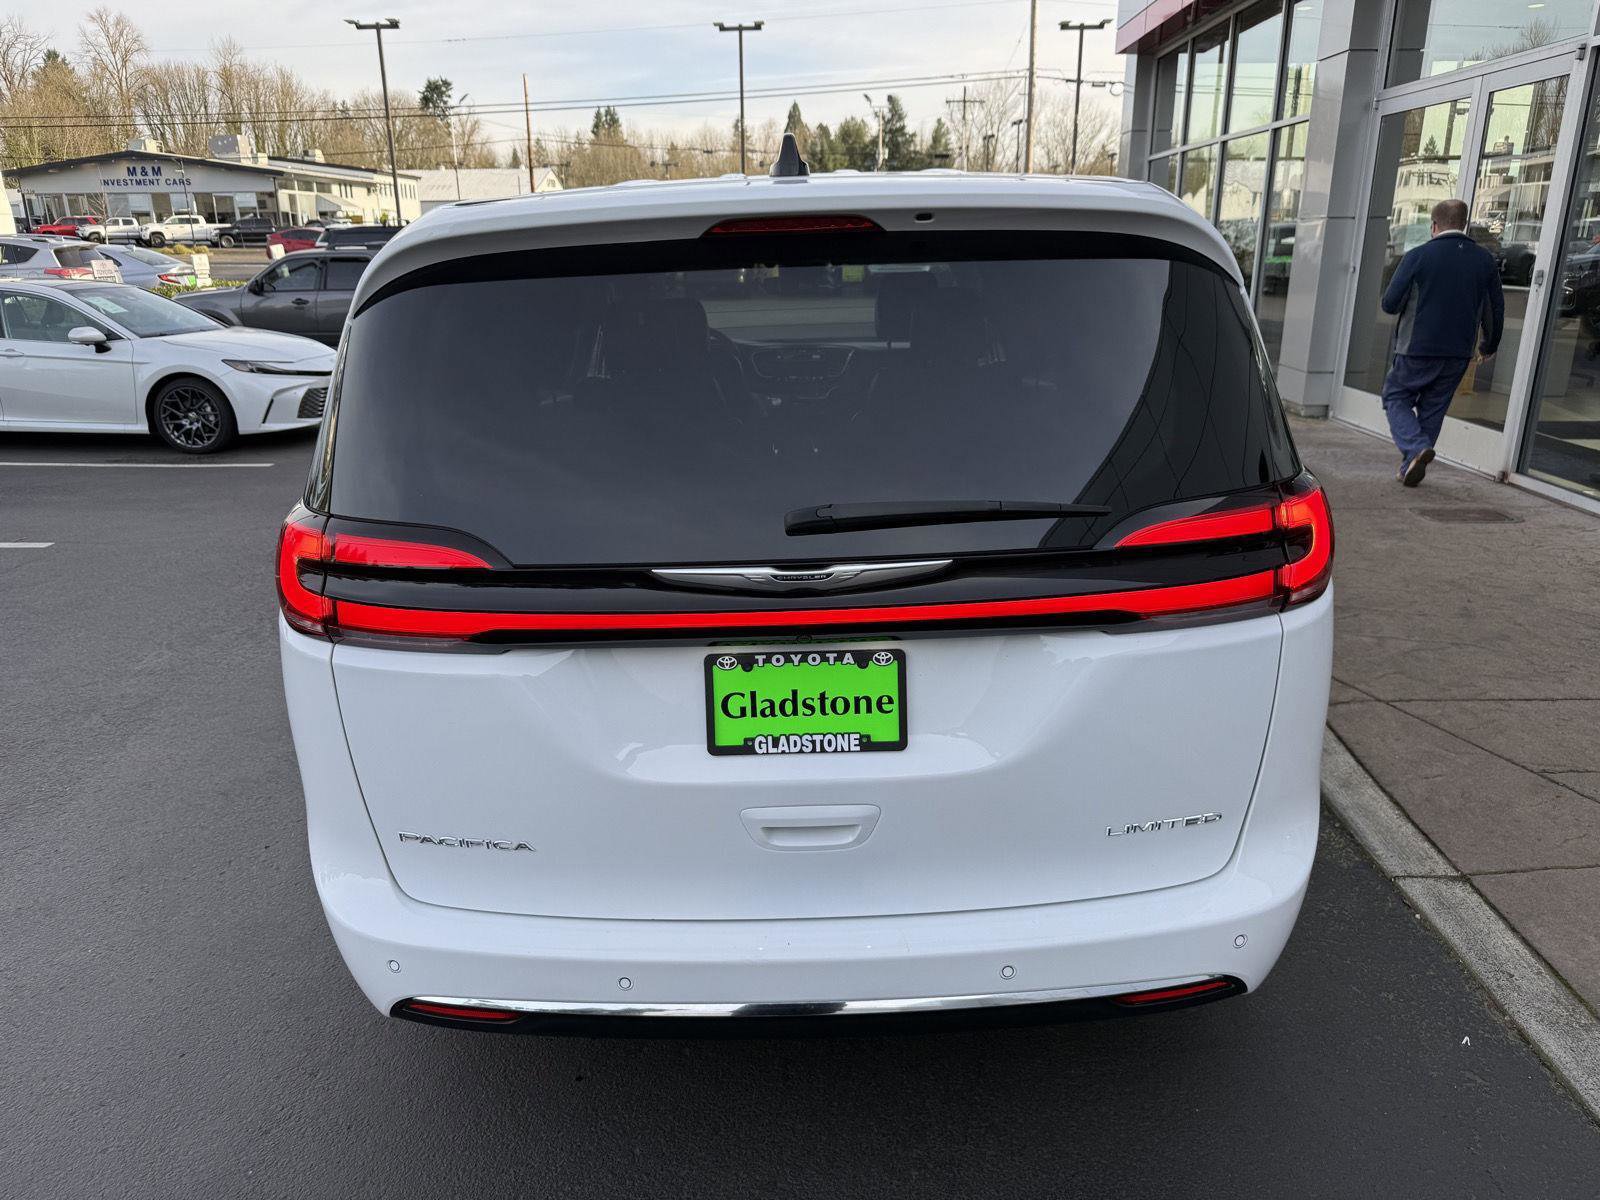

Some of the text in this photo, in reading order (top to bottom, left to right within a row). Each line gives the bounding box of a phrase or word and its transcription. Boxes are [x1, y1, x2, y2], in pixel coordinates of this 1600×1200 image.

[127, 166, 162, 177] M & M
[165, 178, 192, 186] CARS
[755, 653, 855, 667] TOYOTA
[720, 689, 895, 719] Gladstone
[754, 734, 861, 754] GLADSTONE
[1106, 812, 1222, 836] LIMITED
[398, 831, 536, 851] PACIFICA
